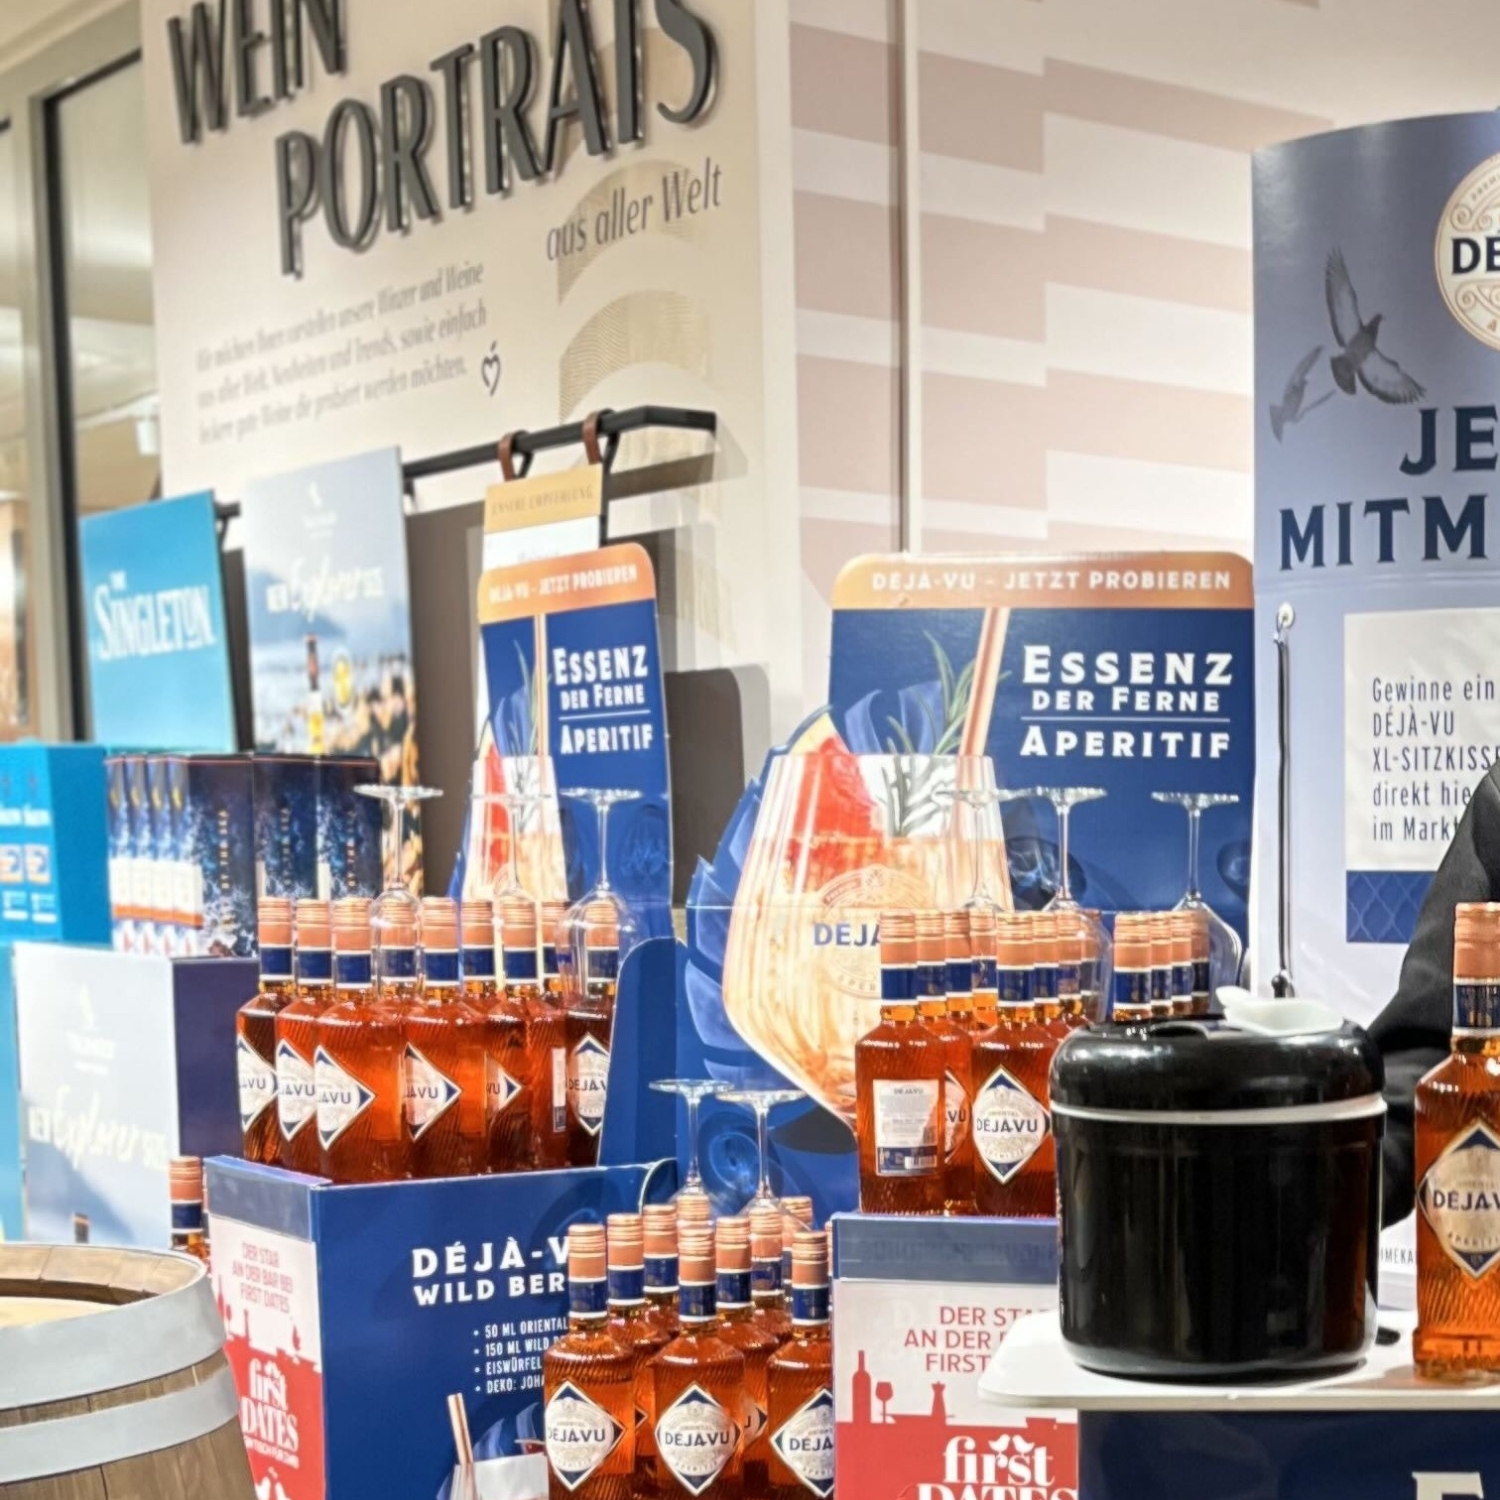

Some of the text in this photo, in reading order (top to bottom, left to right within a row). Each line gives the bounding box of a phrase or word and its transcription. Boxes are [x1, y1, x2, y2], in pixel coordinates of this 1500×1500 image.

[167, 0, 347, 144] WEIN
[546, 157, 722, 261] aus aller Welt
[438, 299, 487, 340] einfach
[1004, 570, 1081, 590] JETZT
[1088, 570, 1231, 590] PROBIEREN
[94, 582, 217, 662] SINGLETON
[553, 644, 649, 686] ESSENZ
[1022, 645, 1233, 686] ESSENZ
[560, 683, 645, 711] DER FERNE
[1032, 686, 1220, 712] DER FERNE
[1372, 674, 1495, 702] Gewinne ein
[1372, 705, 1455, 737] DÉJÀ-VU
[560, 723, 653, 755] APERITIF
[1020, 725, 1231, 759] APERITIF
[1372, 780, 1471, 807] direkt hie
[1373, 817, 1393, 842] im
[412, 1236, 570, 1278] DÉJÀ-V
[413, 1271, 566, 1306] WILD BER
[484, 1317, 569, 1339] 50 ML ORIENTAL
[939, 1306, 986, 1326] DER
[485, 1342, 503, 1357] 150
[507, 1340, 521, 1355] ML
[525, 1336, 550, 1353] WILD
[904, 1328, 937, 1348] AN
[945, 1329, 991, 1350] DER
[486, 1355, 543, 1376] EISWÜRFEL
[925, 1352, 992, 1374] FIRST
[241, 1395, 299, 1453] DATES
[942, 1434, 1055, 1487] first
